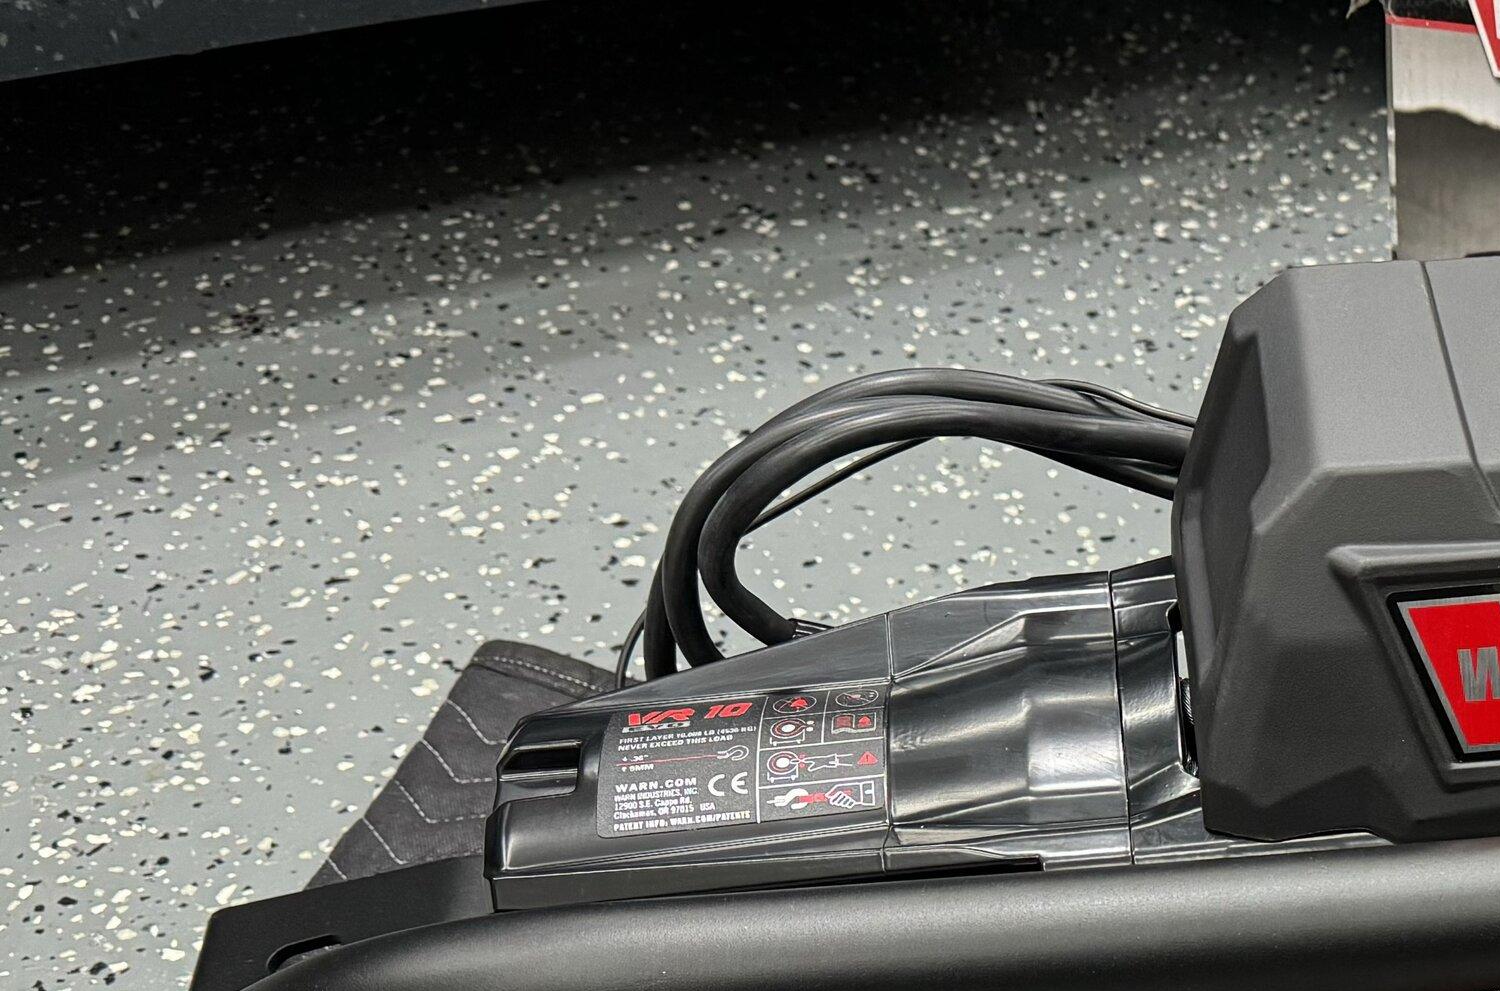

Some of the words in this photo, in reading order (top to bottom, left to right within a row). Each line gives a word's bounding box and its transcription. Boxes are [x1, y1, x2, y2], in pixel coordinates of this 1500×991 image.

[628, 708, 695, 726] VR
[704, 703, 753, 719] 10
[618, 743, 647, 751] NEVER
[650, 740, 685, 748] EXCEED
[686, 737, 707, 745] THIS
[709, 735, 733, 743] LOAD
[619, 736, 644, 744] FIRST
[646, 734, 674, 742] LAYER
[615, 778, 697, 793] WARN.COM
[614, 793, 636, 802] WARN
[614, 802, 637, 810] 12900
[671, 805, 694, 814] 97015
[700, 802, 716, 811] USA
[614, 821, 643, 831] PATENT
[670, 810, 751, 826] WARN.COM/PATENTS
